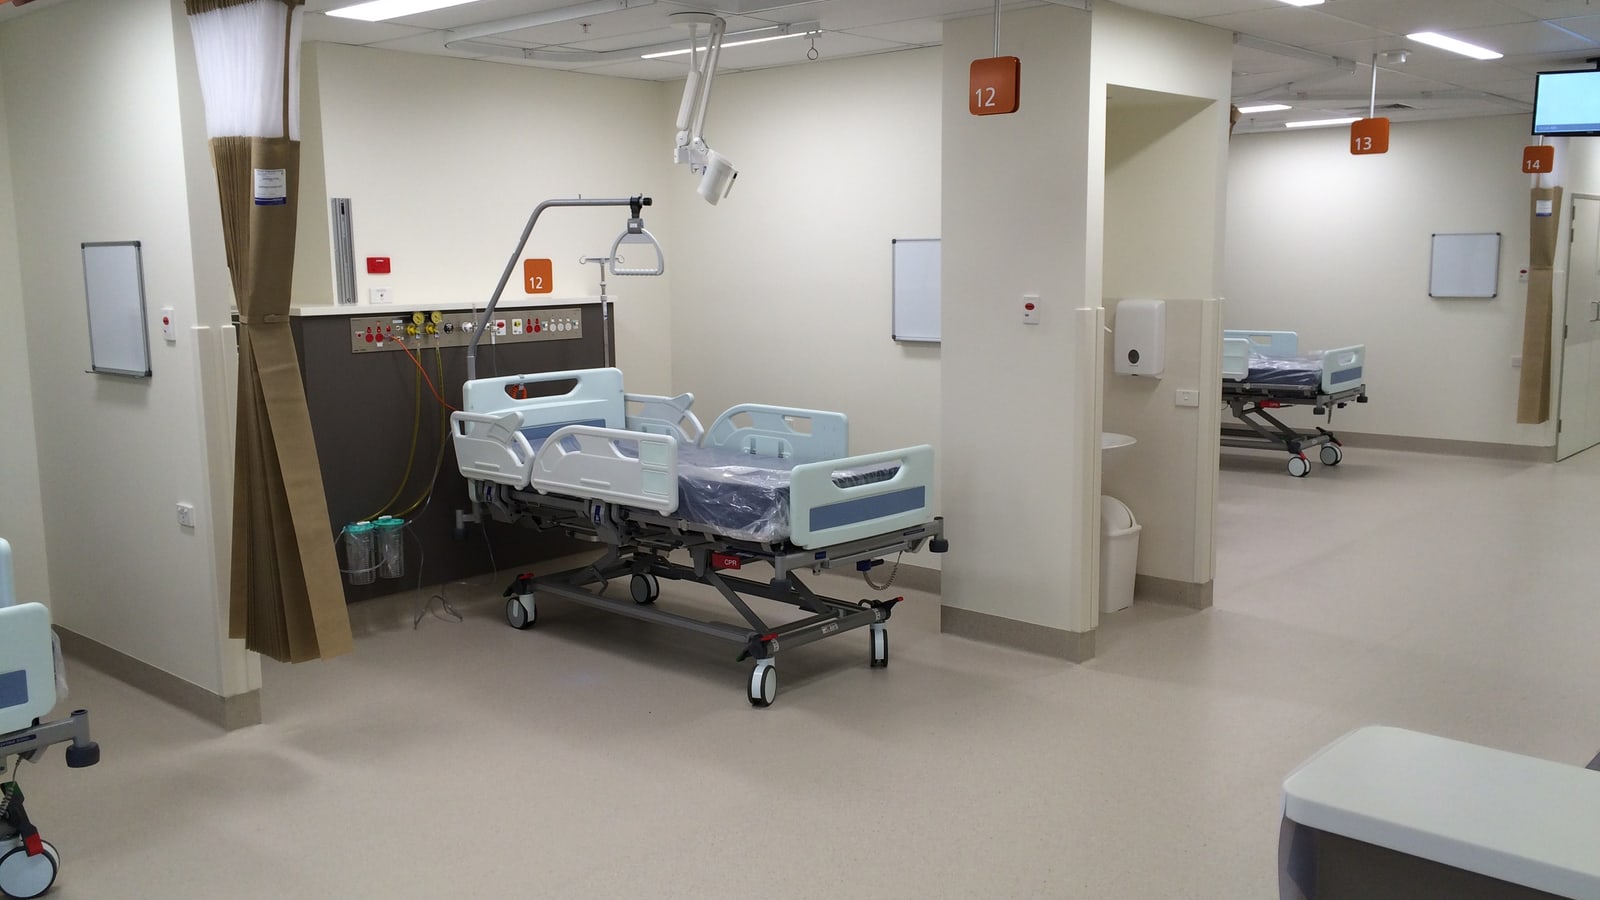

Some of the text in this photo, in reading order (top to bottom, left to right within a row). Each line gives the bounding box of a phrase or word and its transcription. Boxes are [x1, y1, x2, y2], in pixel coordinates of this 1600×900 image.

[975, 87, 996, 108] 12
[1355, 136, 1372, 151] 13
[1526, 159, 1541, 170] 14
[529, 276, 543, 289] 12
[724, 558, 737, 567] CPR
